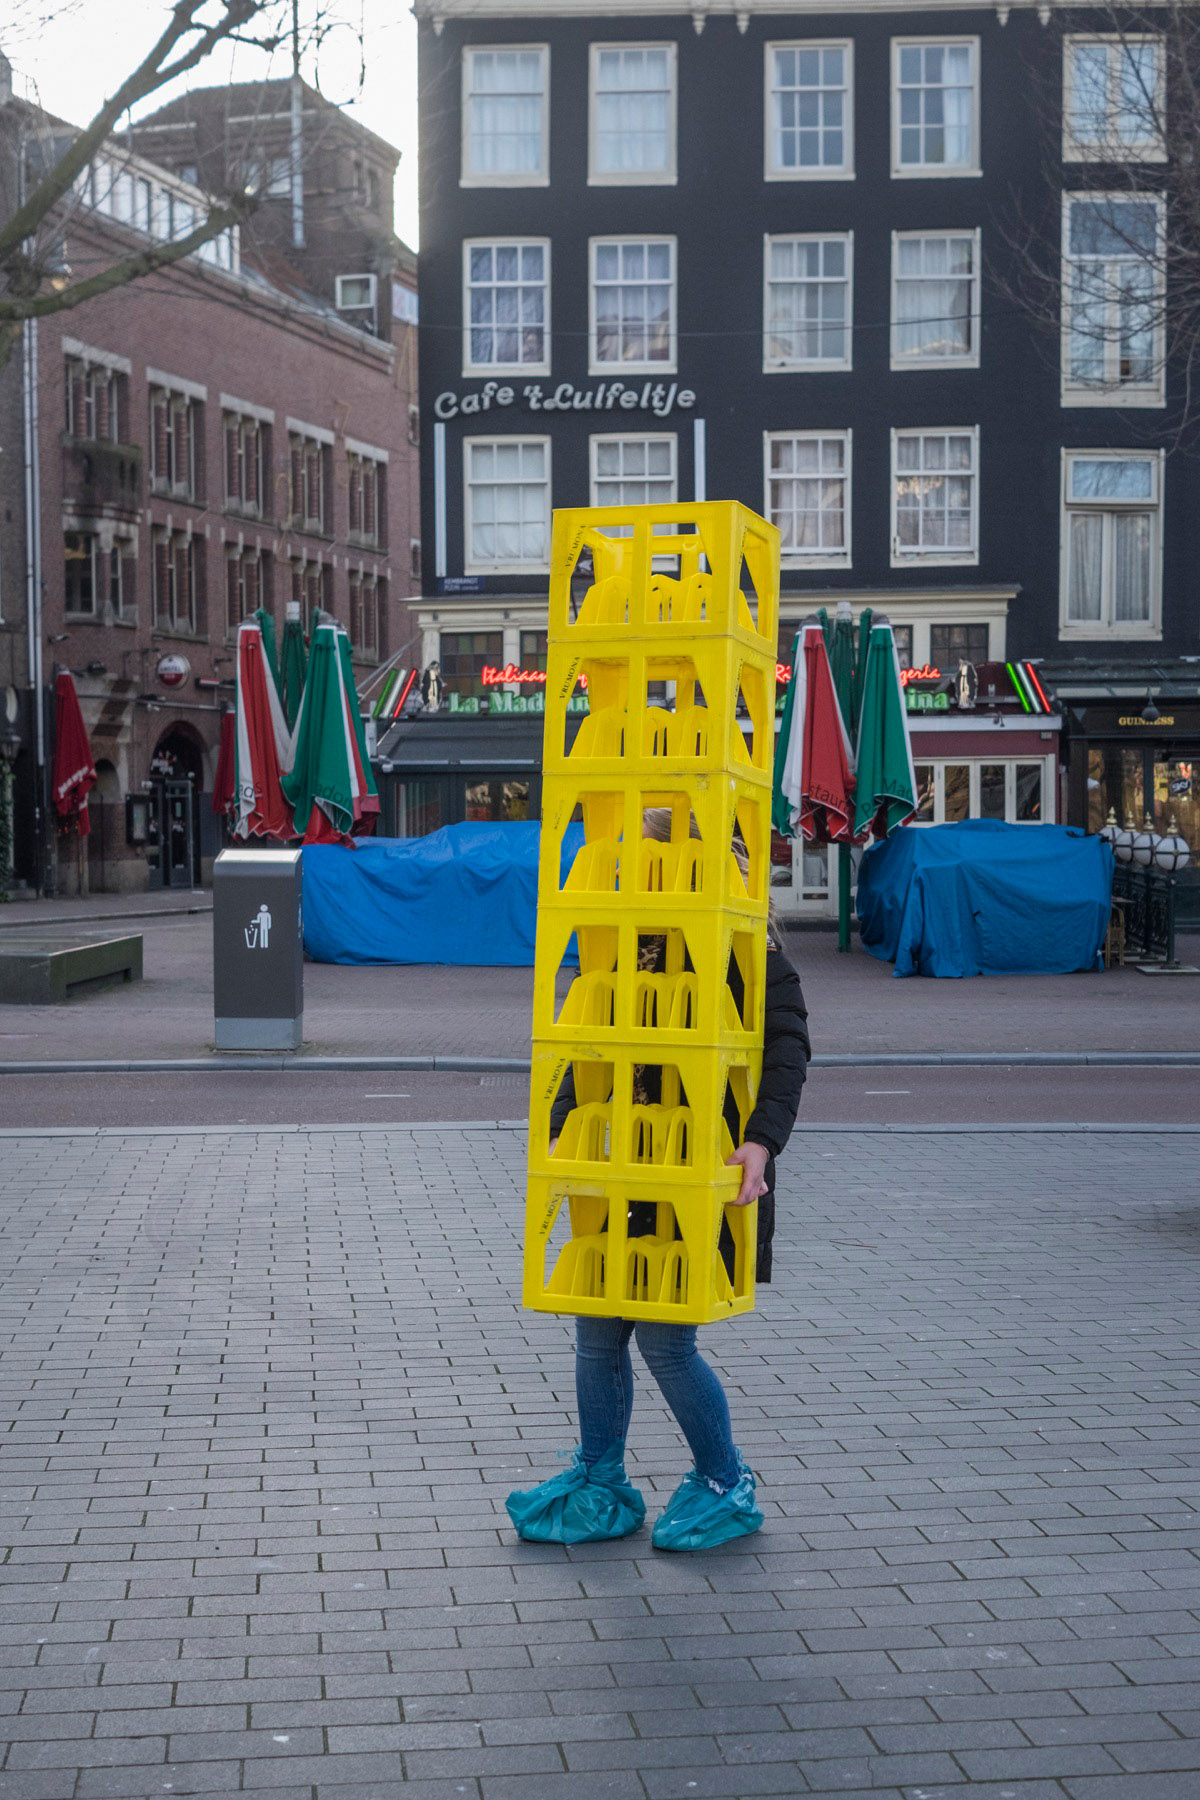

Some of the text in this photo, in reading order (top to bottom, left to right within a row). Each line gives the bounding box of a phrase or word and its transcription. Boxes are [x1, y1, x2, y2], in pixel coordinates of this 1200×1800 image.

[434, 382, 514, 419] Cafe
[565, 525, 587, 568] VRUMONA
[559, 656, 580, 699] VRUMONA
[449, 691, 479, 713] La
[908, 688, 949, 709] ina
[1118, 716, 1175, 726] GUINESS
[544, 1058, 565, 1099] VRUMONA
[539, 1193, 562, 1235] VRUMONA
